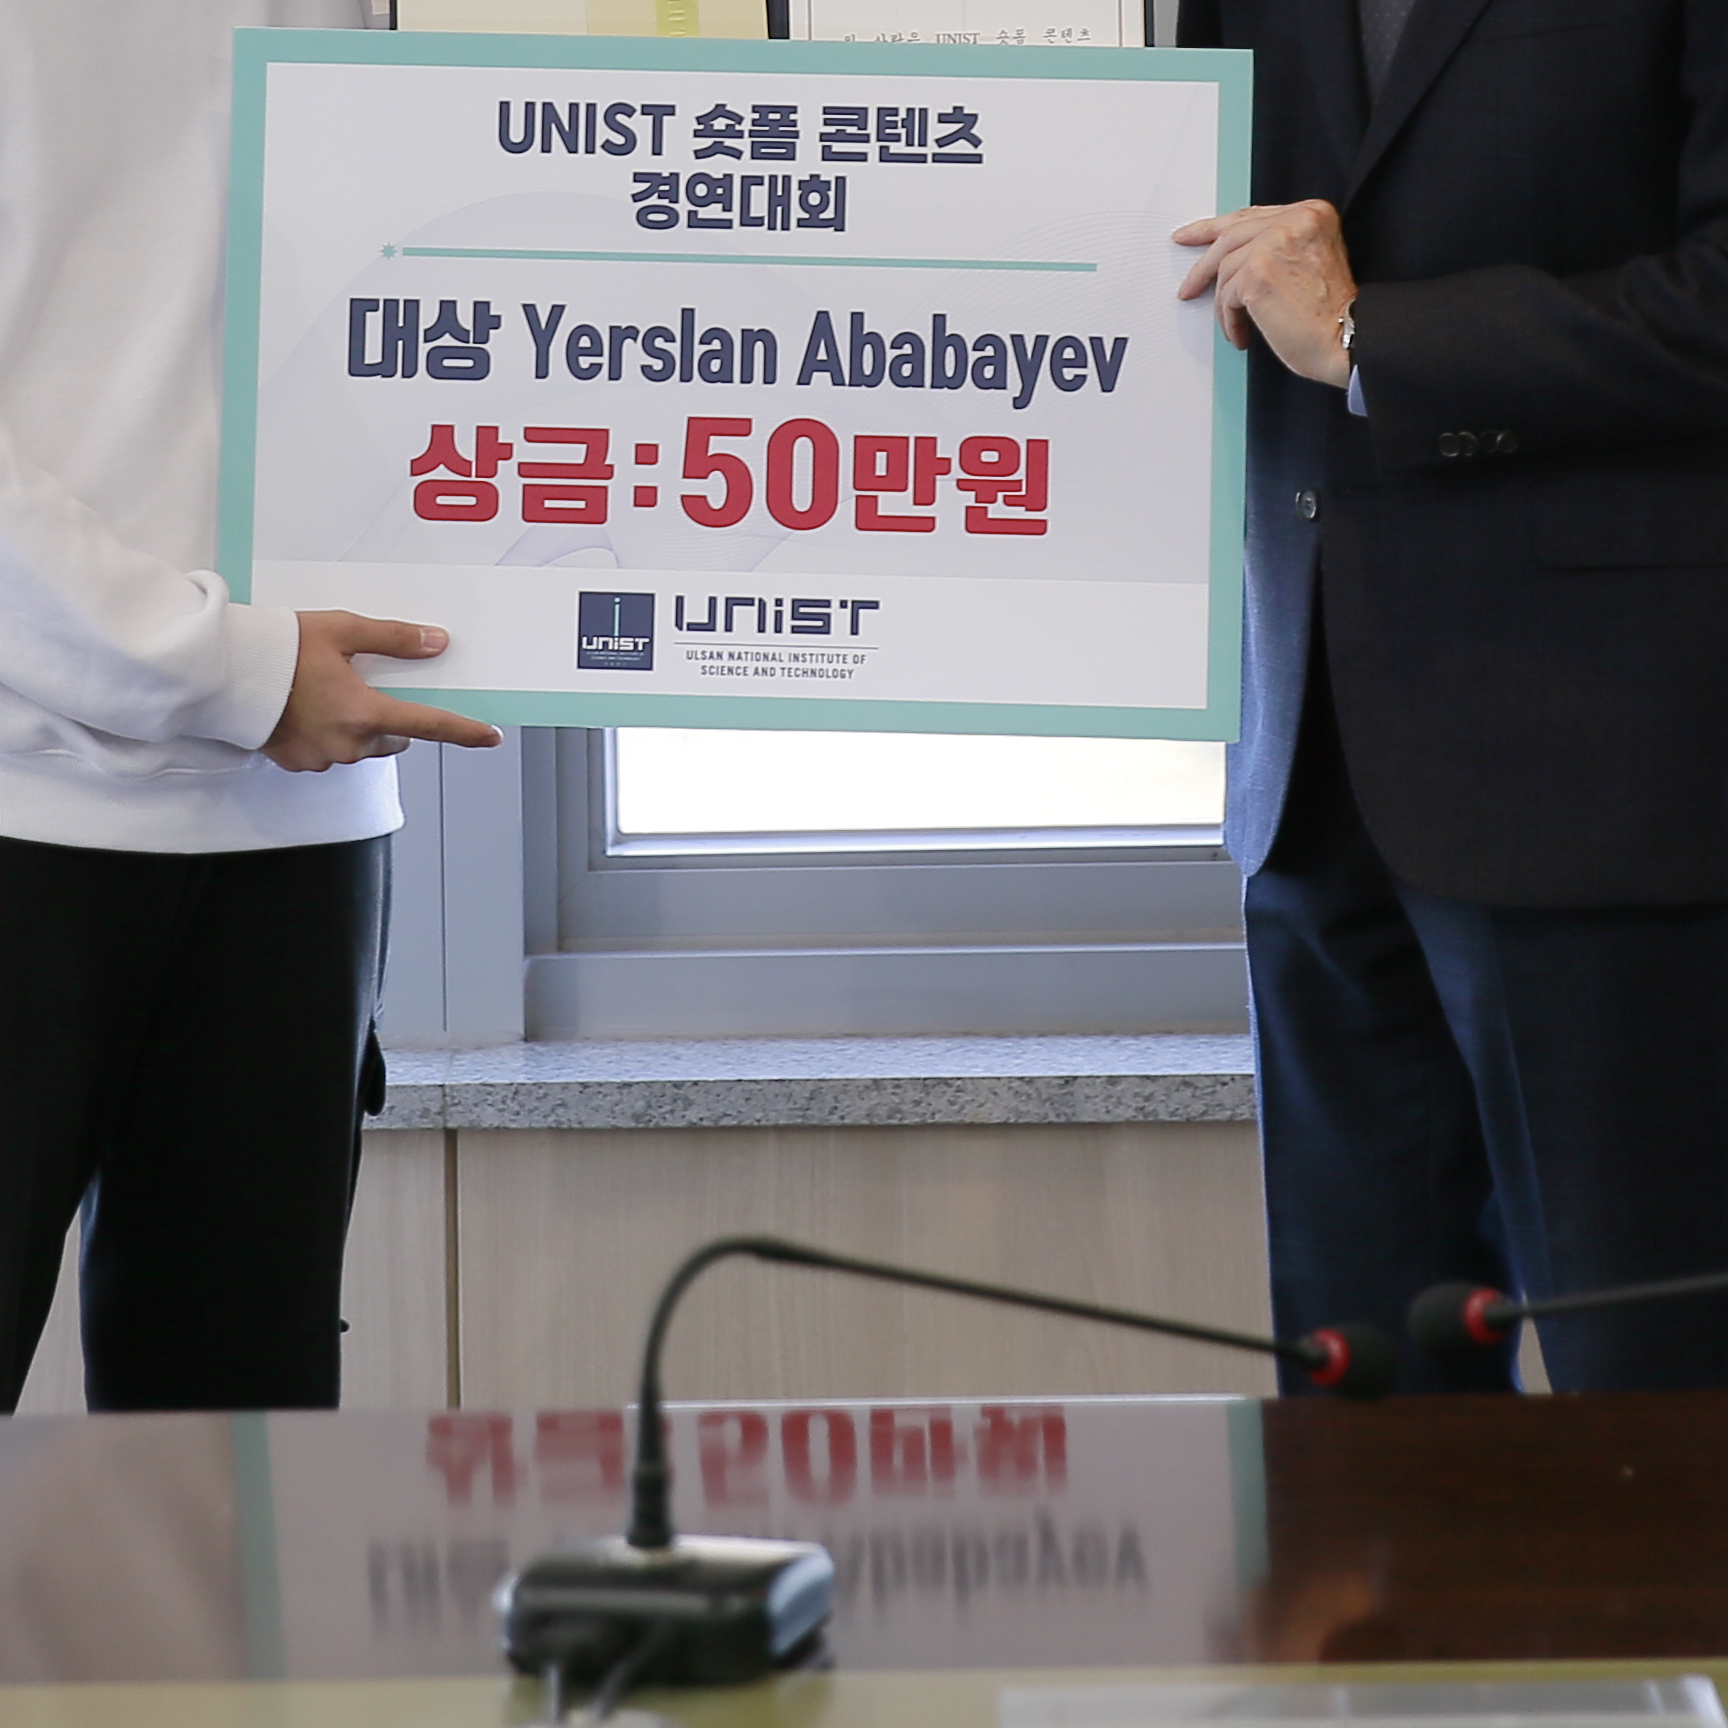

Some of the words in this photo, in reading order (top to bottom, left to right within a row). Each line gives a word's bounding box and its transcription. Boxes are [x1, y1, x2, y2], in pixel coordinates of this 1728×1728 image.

[936, 33, 981, 45] UNIST
[995, 29, 1026, 45] 숏폼
[1043, 28, 1091, 44] 콘텐츠
[498, 101, 676, 156] UNIST
[693, 103, 800, 161] 숏폼
[819, 105, 984, 164] 콘텐츠
[630, 172, 848, 232] 경연대회
[347, 297, 502, 381] 대상
[521, 303, 778, 386] Yerslan
[797, 310, 1129, 410] Ababayev
[410, 416, 1050, 535] 상금:50만원
[686, 649, 724, 662] ULSAN
[728, 651, 784, 663] NATIONAL
[788, 652, 849, 665] INSTITUTE
[852, 654, 867, 665] OF
[701, 666, 750, 677] SCIENCE
[753, 667, 777, 678] AND
[780, 667, 855, 680] TECHNOLOGY
